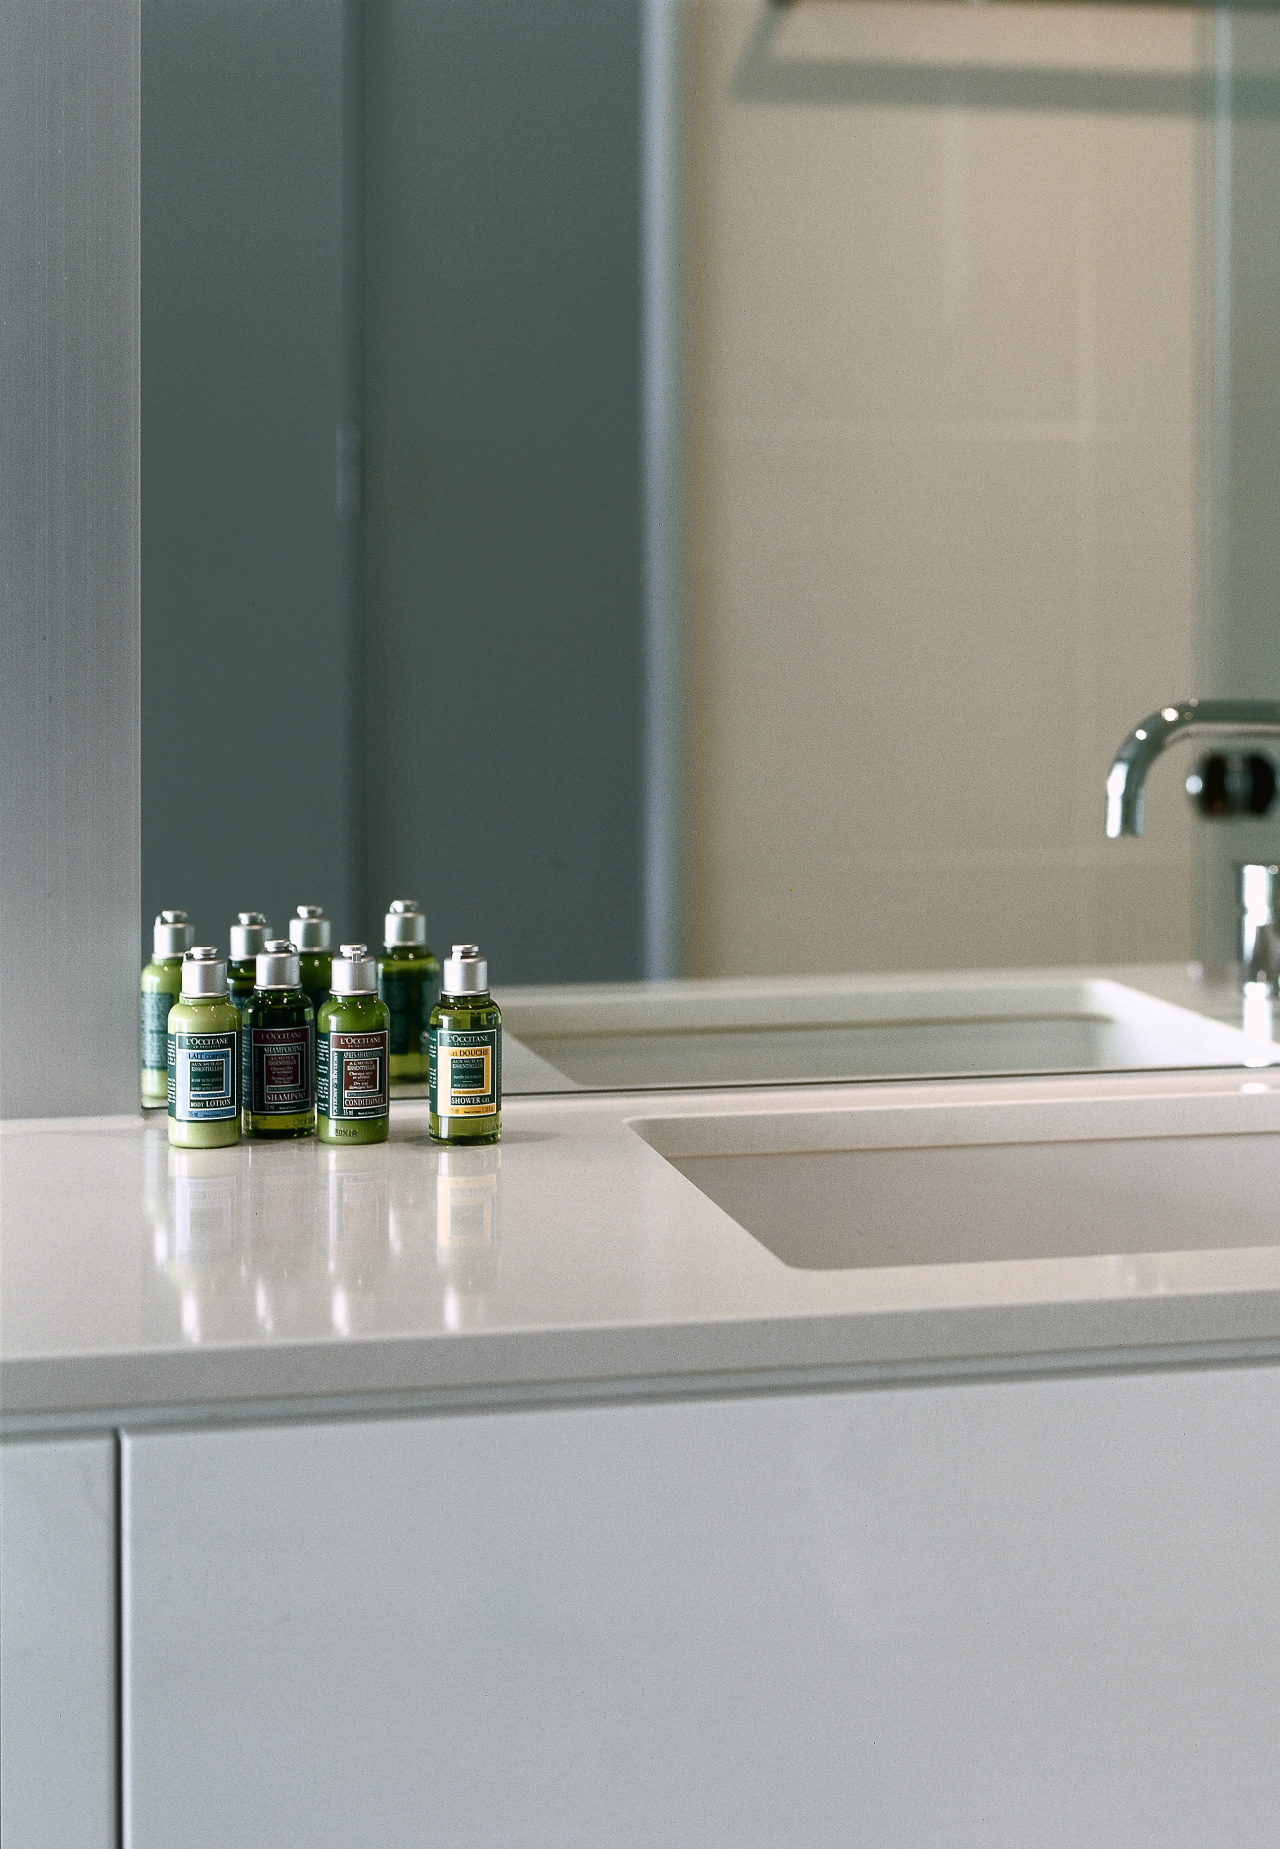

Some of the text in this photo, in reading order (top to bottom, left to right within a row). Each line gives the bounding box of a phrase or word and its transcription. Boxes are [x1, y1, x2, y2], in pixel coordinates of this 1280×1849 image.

[340, 1037, 381, 1045] L'OCCITANE
[266, 1092, 306, 1101] SHAMPOO
[206, 1099, 231, 1107] LOTION
[345, 1097, 383, 1106] CONDITIONER
